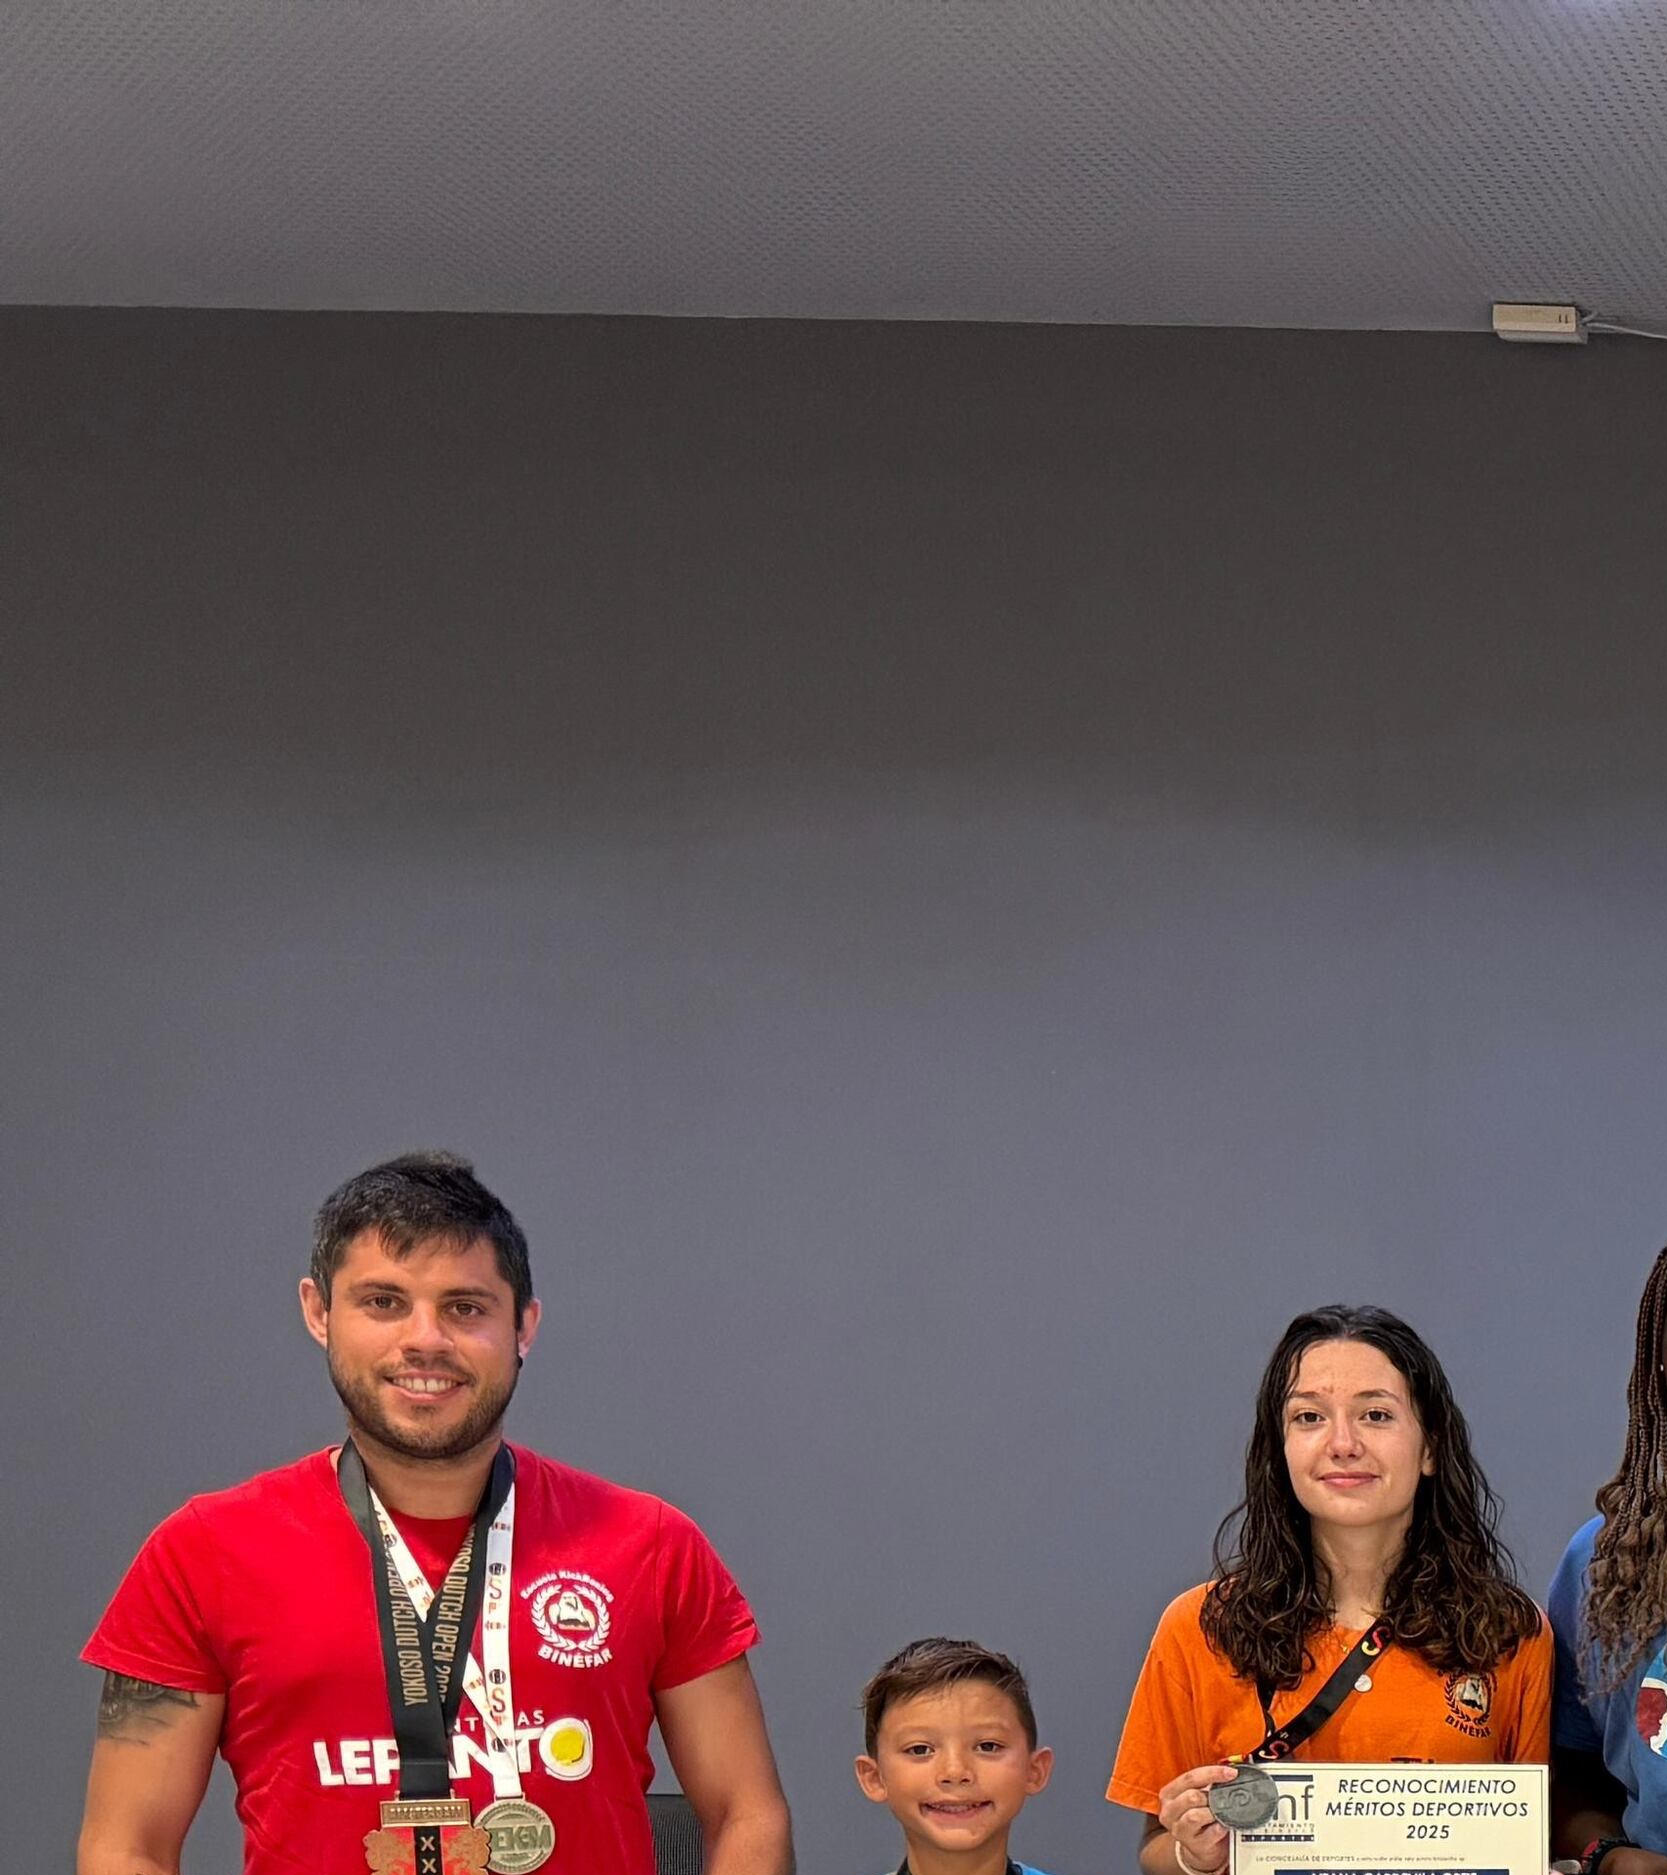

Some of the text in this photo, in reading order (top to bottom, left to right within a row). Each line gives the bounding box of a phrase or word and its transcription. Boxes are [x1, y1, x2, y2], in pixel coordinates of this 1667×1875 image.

[438, 1575, 469, 1622] DUTCH
[391, 1600, 420, 1647] DUTCH
[431, 1623, 460, 1663] OPEN
[538, 1643, 613, 1669] BINÉFAR
[398, 1651, 429, 1707] YOKOSO
[1277, 1784, 1315, 1822] nf
[1337, 1777, 1516, 1795] RECONOCIMIENTO
[1324, 1795, 1528, 1817] MÉRITOS DEPORTIVOS
[1405, 1823, 1450, 1840] 2025
